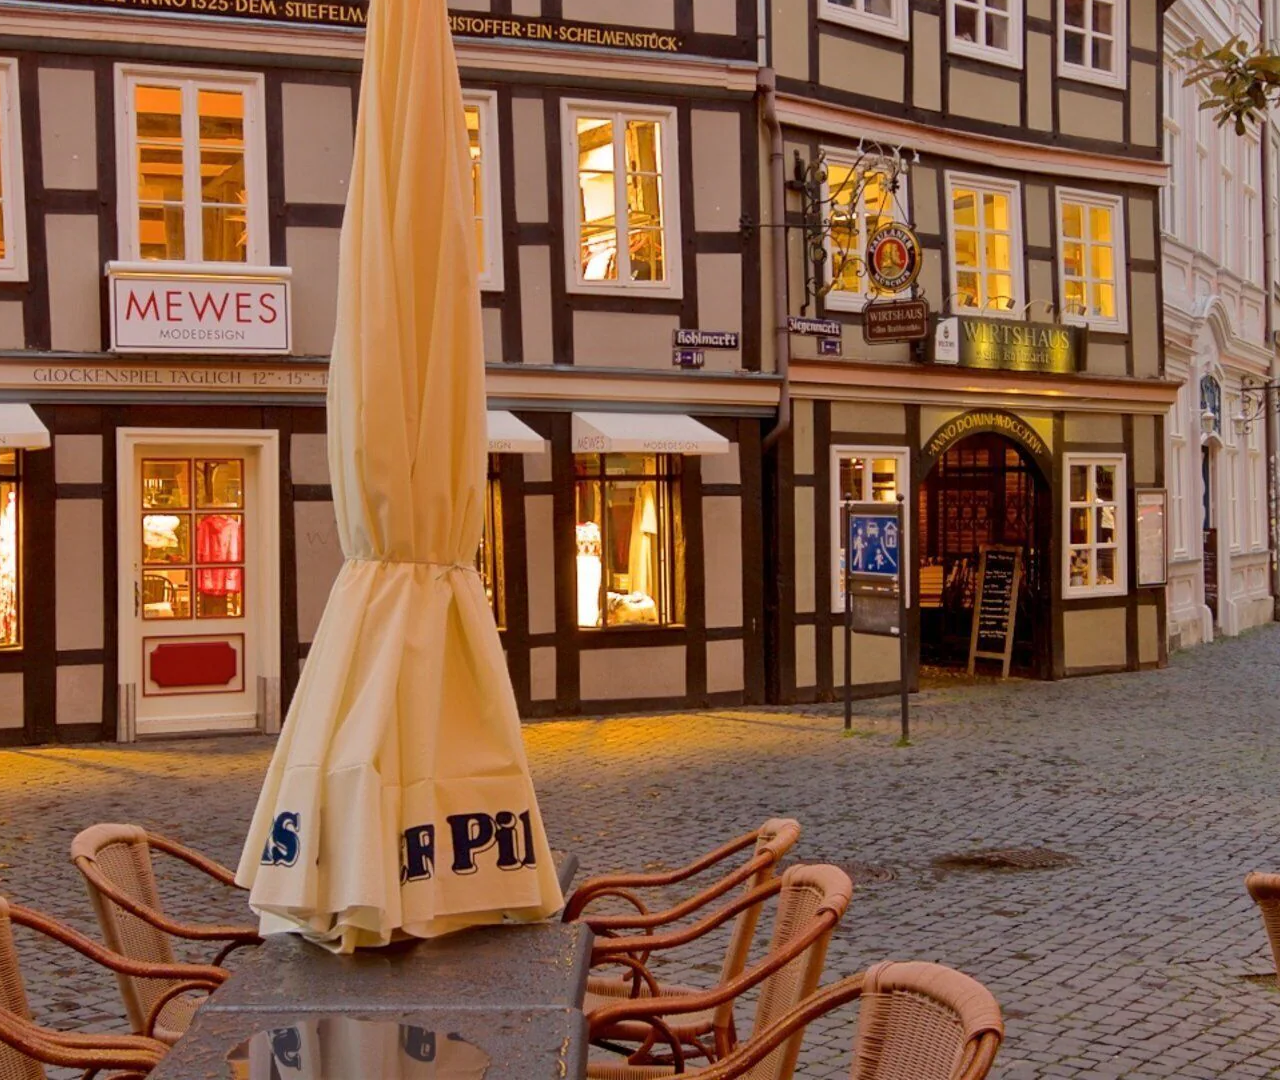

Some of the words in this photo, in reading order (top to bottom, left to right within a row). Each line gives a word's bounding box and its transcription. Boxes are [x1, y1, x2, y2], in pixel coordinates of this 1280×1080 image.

[285, 2, 370, 23] STIEFELM
[527, 23, 553, 40] EIN
[559, 27, 678, 52] SCHELMENSTÜCK
[869, 228, 914, 253] PAULANER
[125, 290, 277, 323] MEWES
[869, 307, 923, 322] WIRTSHAUS
[160, 328, 245, 340] MODEDESIGN
[677, 330, 736, 347] Kohlmarkt
[962, 320, 1070, 349] WIRTSHAUS
[33, 368, 163, 384] GLOCKENSPIEL
[643, 441, 699, 450] MODEDESIGN
